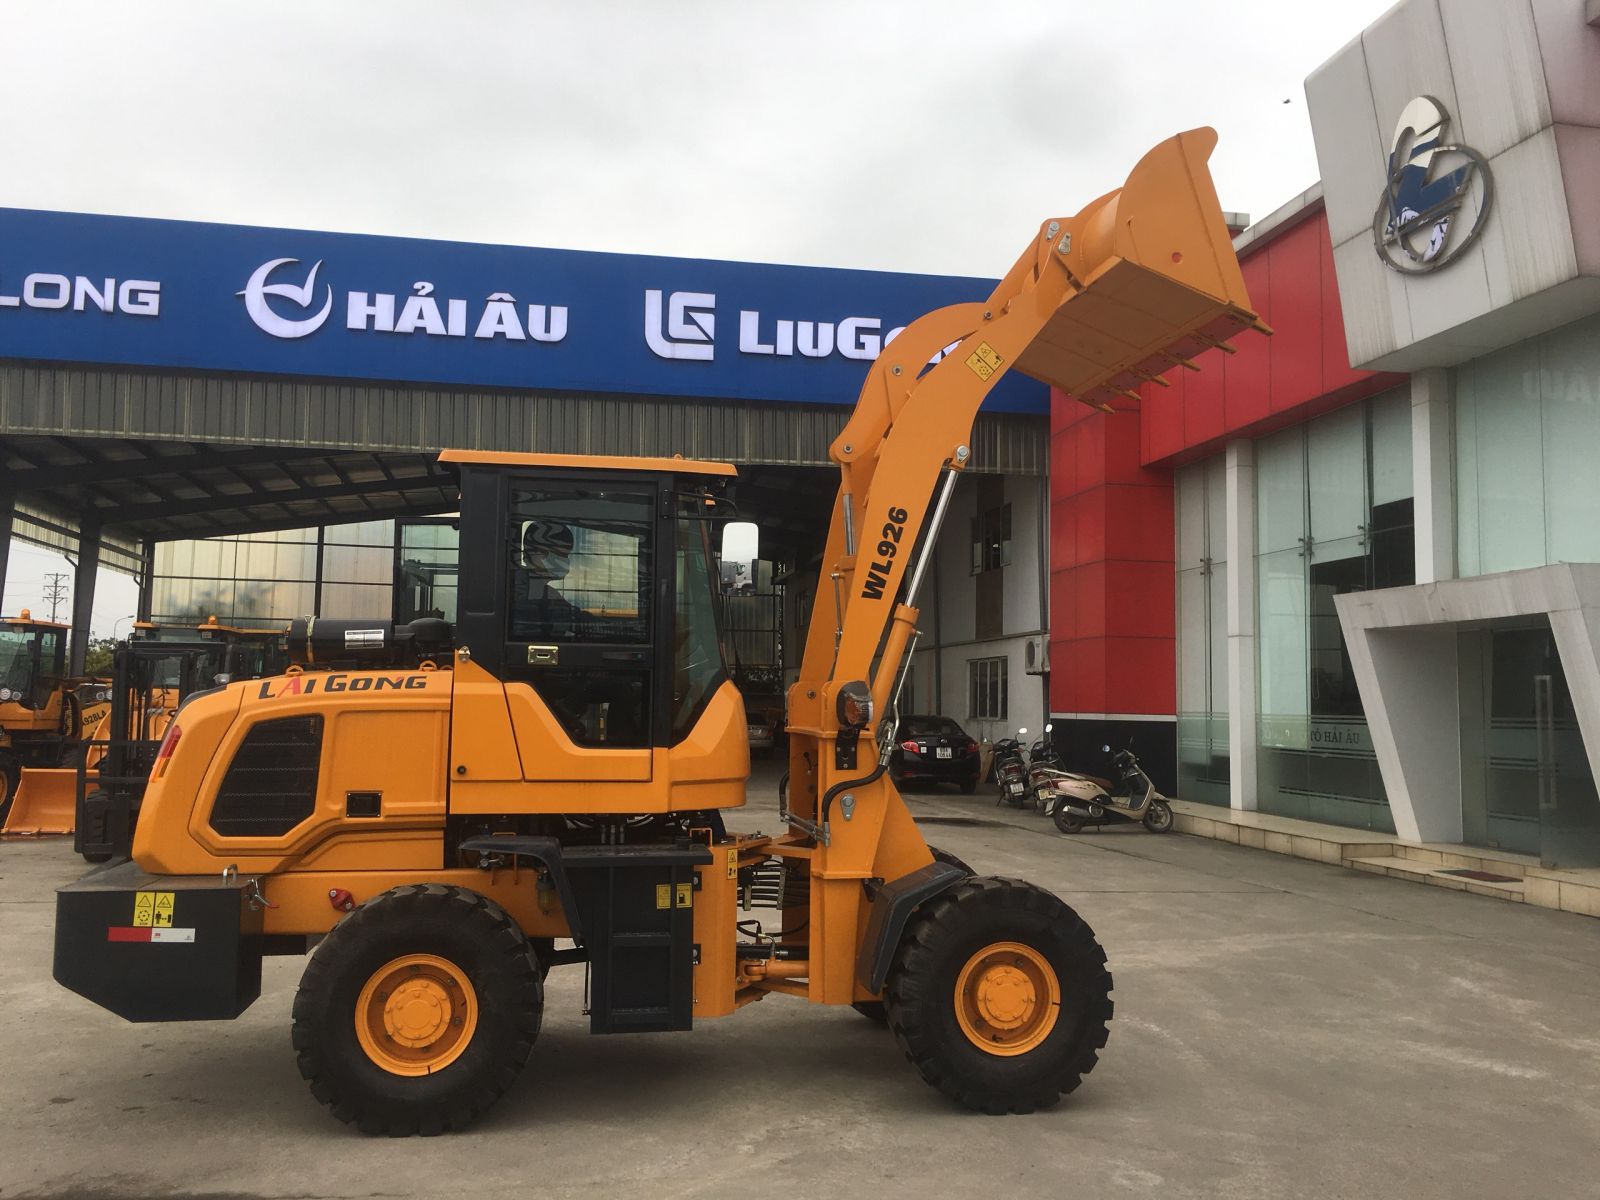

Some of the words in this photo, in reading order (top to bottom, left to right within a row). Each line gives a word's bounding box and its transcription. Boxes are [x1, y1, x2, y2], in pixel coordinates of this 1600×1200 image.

[346, 281, 466, 336] HẢI
[474, 292, 568, 342] ÂU
[739, 310, 962, 364] LIUG
[861, 506, 908, 600] WL926
